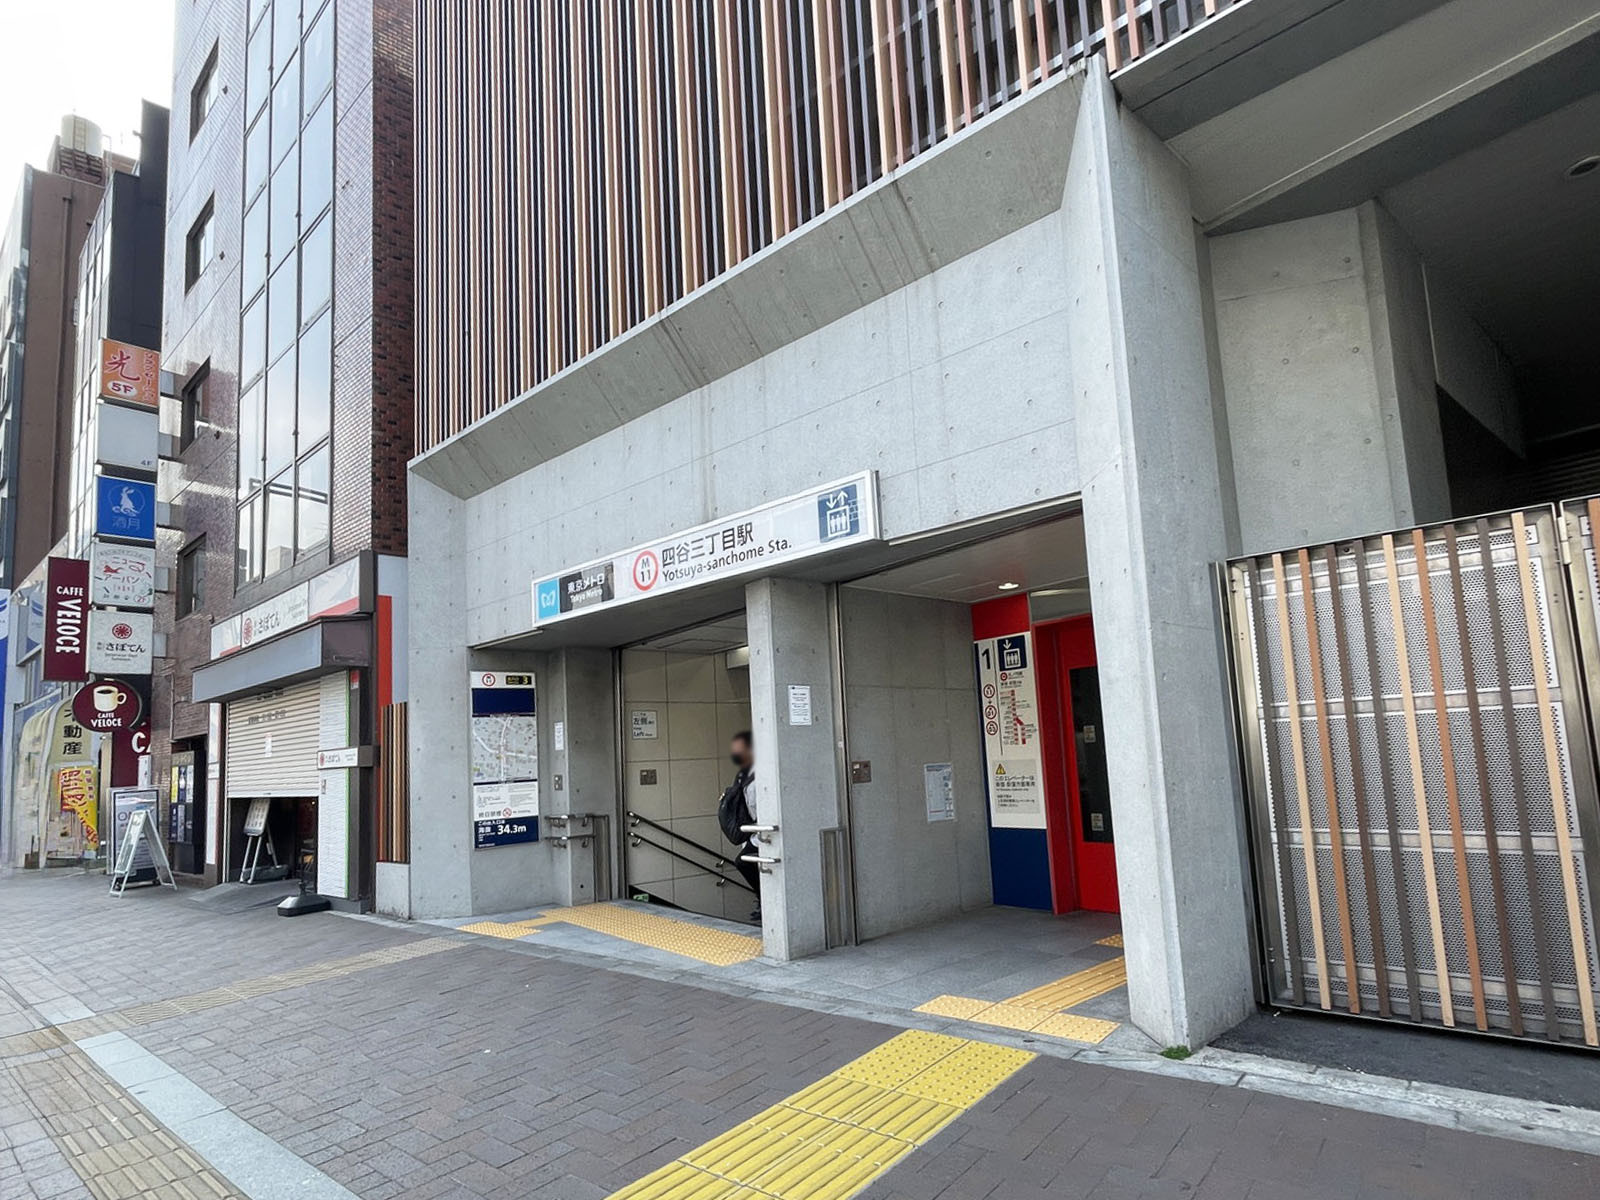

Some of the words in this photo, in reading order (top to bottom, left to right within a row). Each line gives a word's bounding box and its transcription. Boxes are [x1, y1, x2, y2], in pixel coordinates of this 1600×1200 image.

[106, 350, 141, 382] 光
[111, 382, 133, 394] 5F
[662, 522, 754, 568] 四谷三丁目駅
[641, 558, 650, 567] M
[662, 547, 765, 583] Yotsuya-sanchome
[768, 537, 792, 554] Sta.
[567, 573, 605, 594] 東京メトロ
[640, 570, 651, 583] 11
[56, 586, 84, 597] CAFFE
[570, 591, 586, 603] Tokyo
[586, 588, 603, 600] Metro
[55, 599, 82, 654] VELOCE
[982, 648, 991, 670] 1
[522, 675, 529, 685] 3
[91, 718, 122, 727] VELOCE
[497, 824, 527, 835] 34.3m
